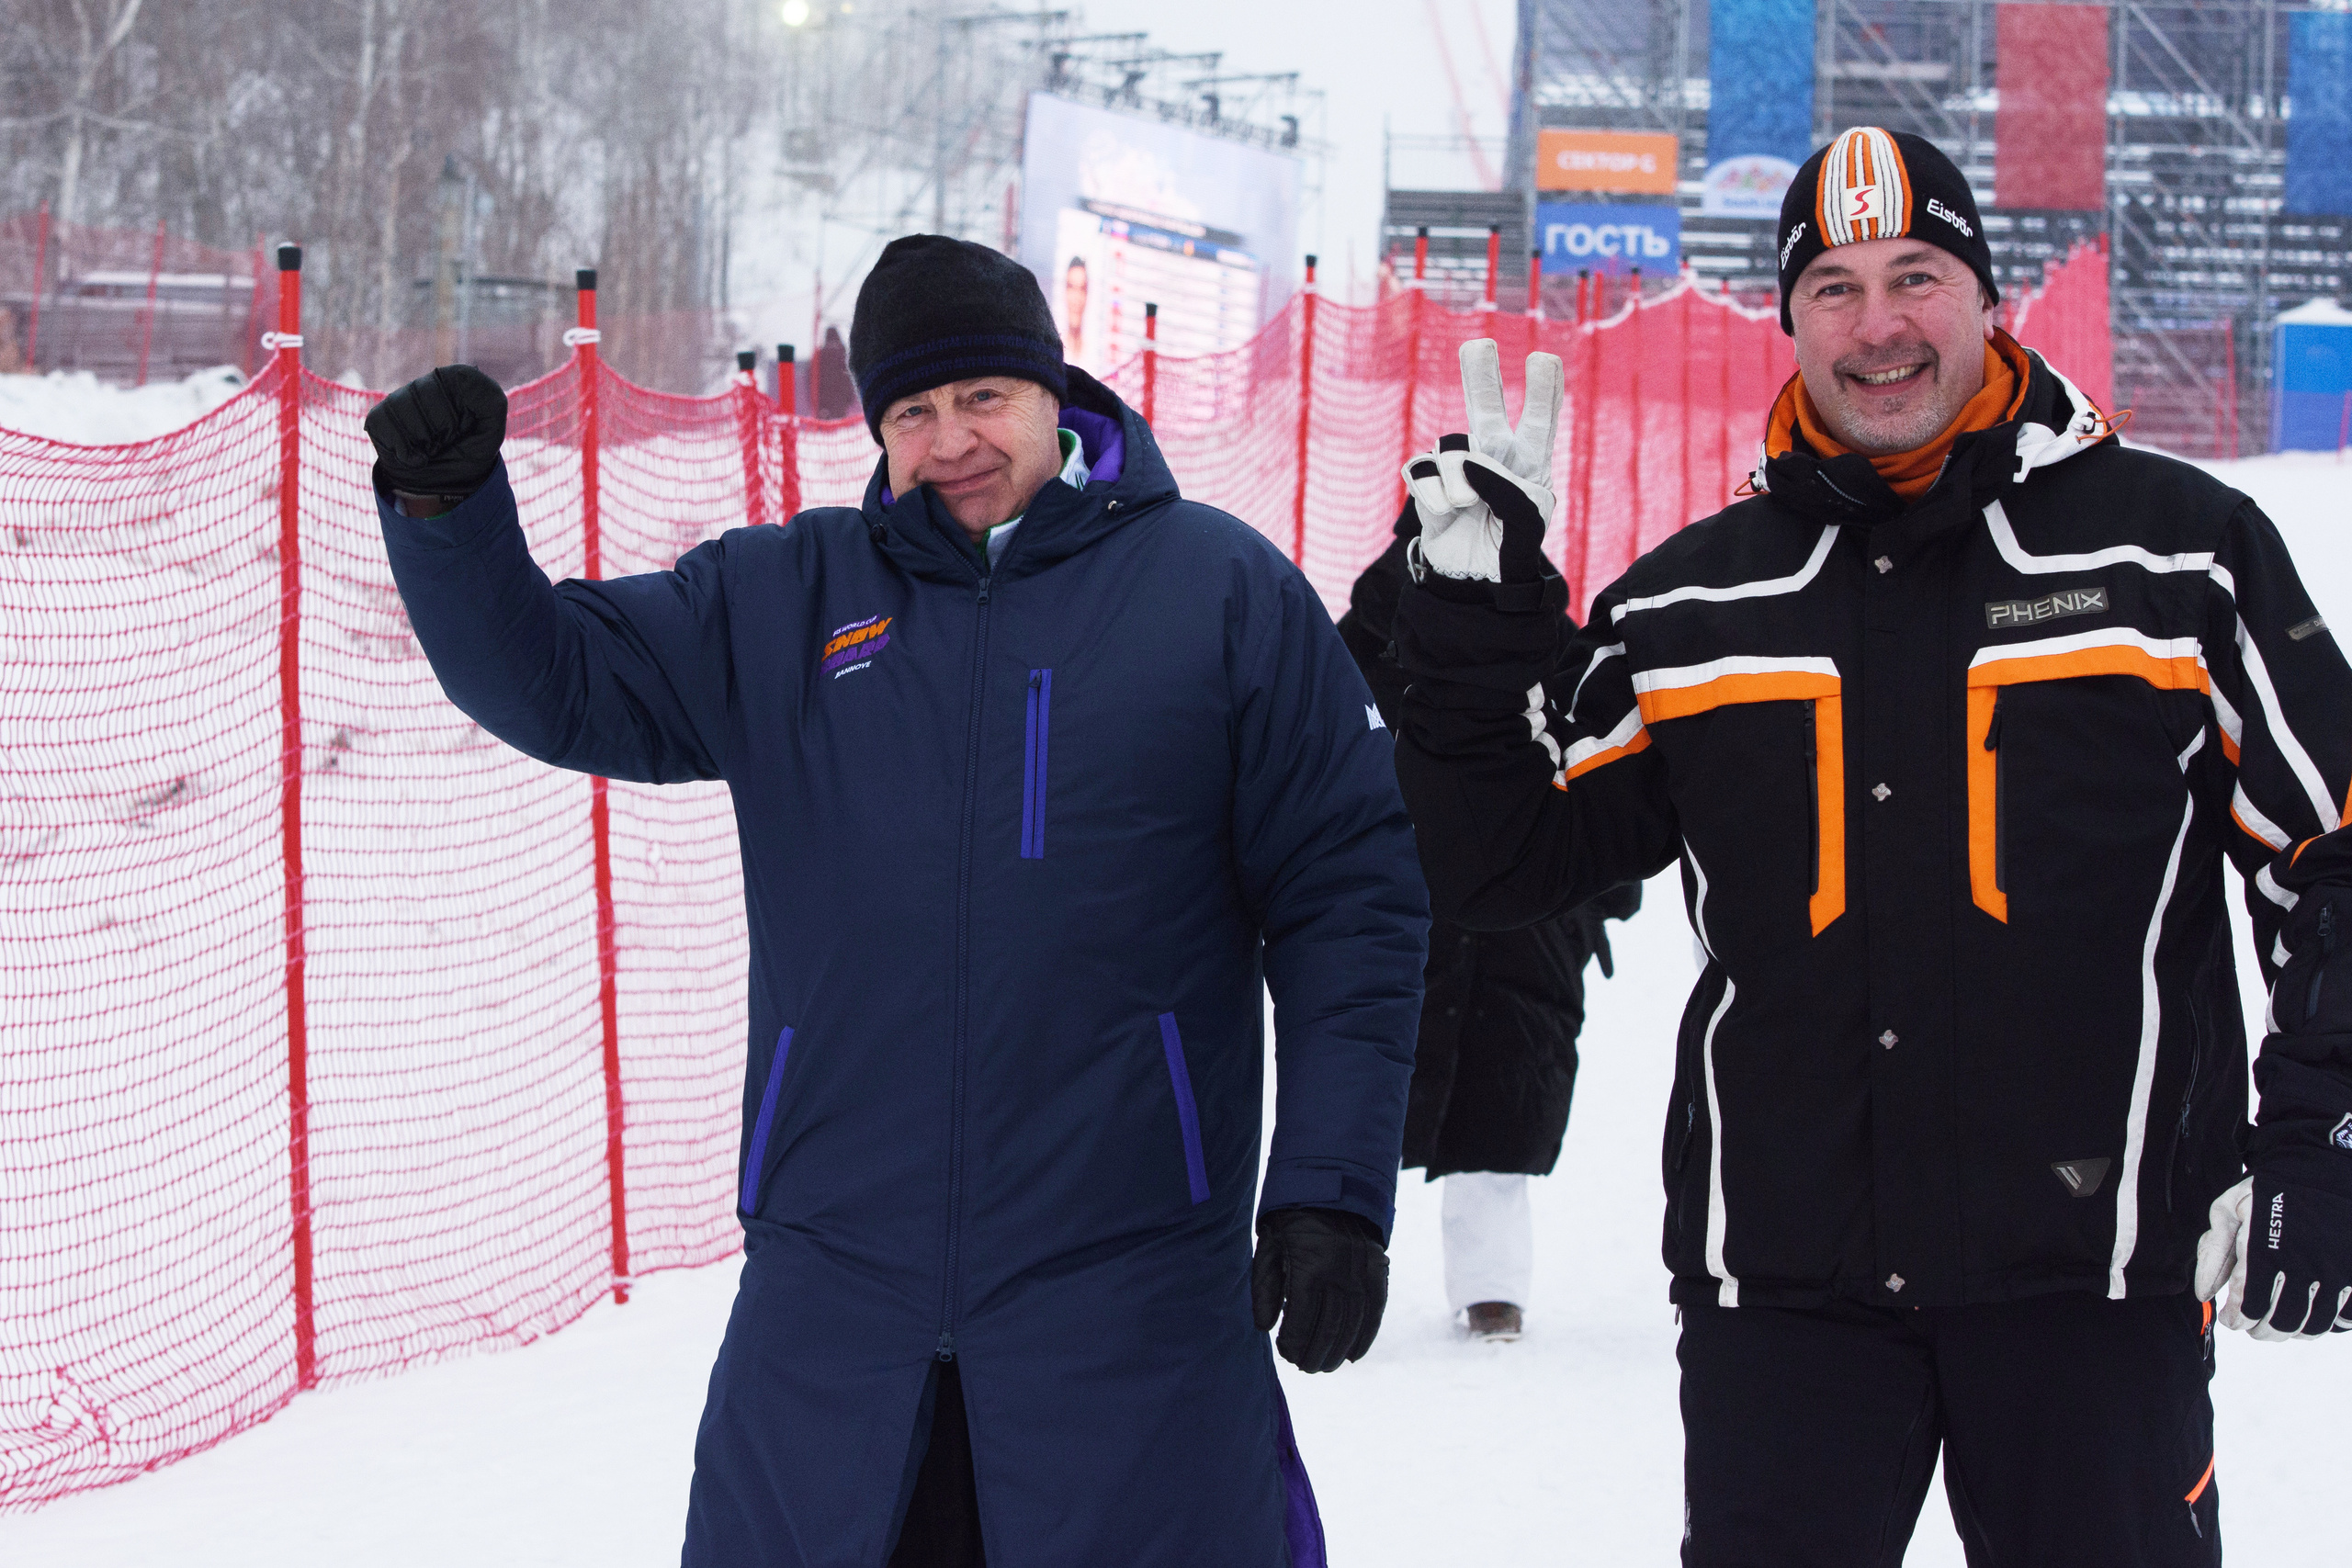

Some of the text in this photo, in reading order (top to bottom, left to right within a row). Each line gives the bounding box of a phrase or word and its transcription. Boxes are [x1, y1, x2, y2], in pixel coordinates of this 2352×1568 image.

[1926, 197, 1973, 239] Eisbär
[1544, 223, 1670, 257] ГОСТЬ
[1780, 220, 1807, 271] Eisbär
[842, 621, 865, 632] WORLD
[1990, 592, 2104, 625] PHENIX
[821, 616, 893, 663] SNOW
[2267, 1191, 2284, 1250] HESTRA
